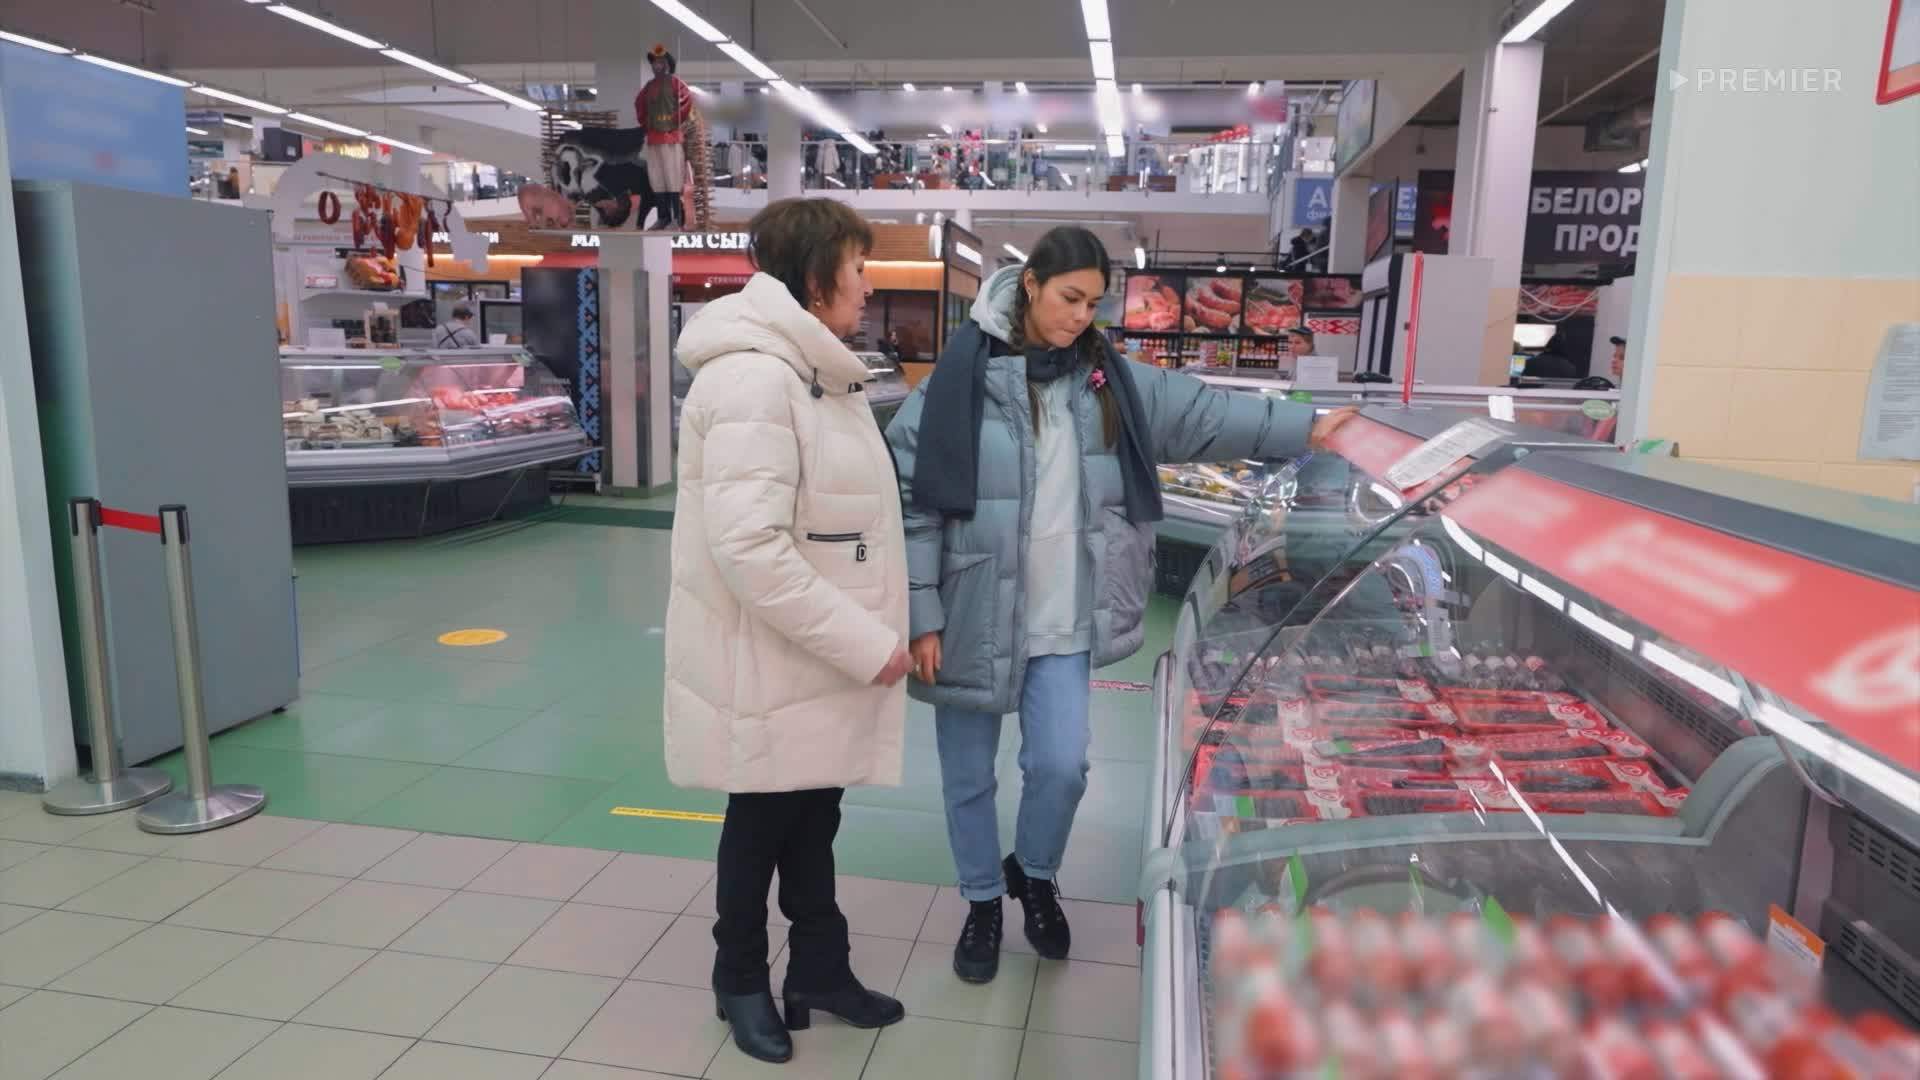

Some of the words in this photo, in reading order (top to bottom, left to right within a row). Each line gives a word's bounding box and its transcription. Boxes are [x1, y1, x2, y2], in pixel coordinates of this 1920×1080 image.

[1531, 187, 1642, 215] БЕЛОР
[706, 232, 755, 249] СЫР
[1554, 223, 1641, 257] ПРОД
